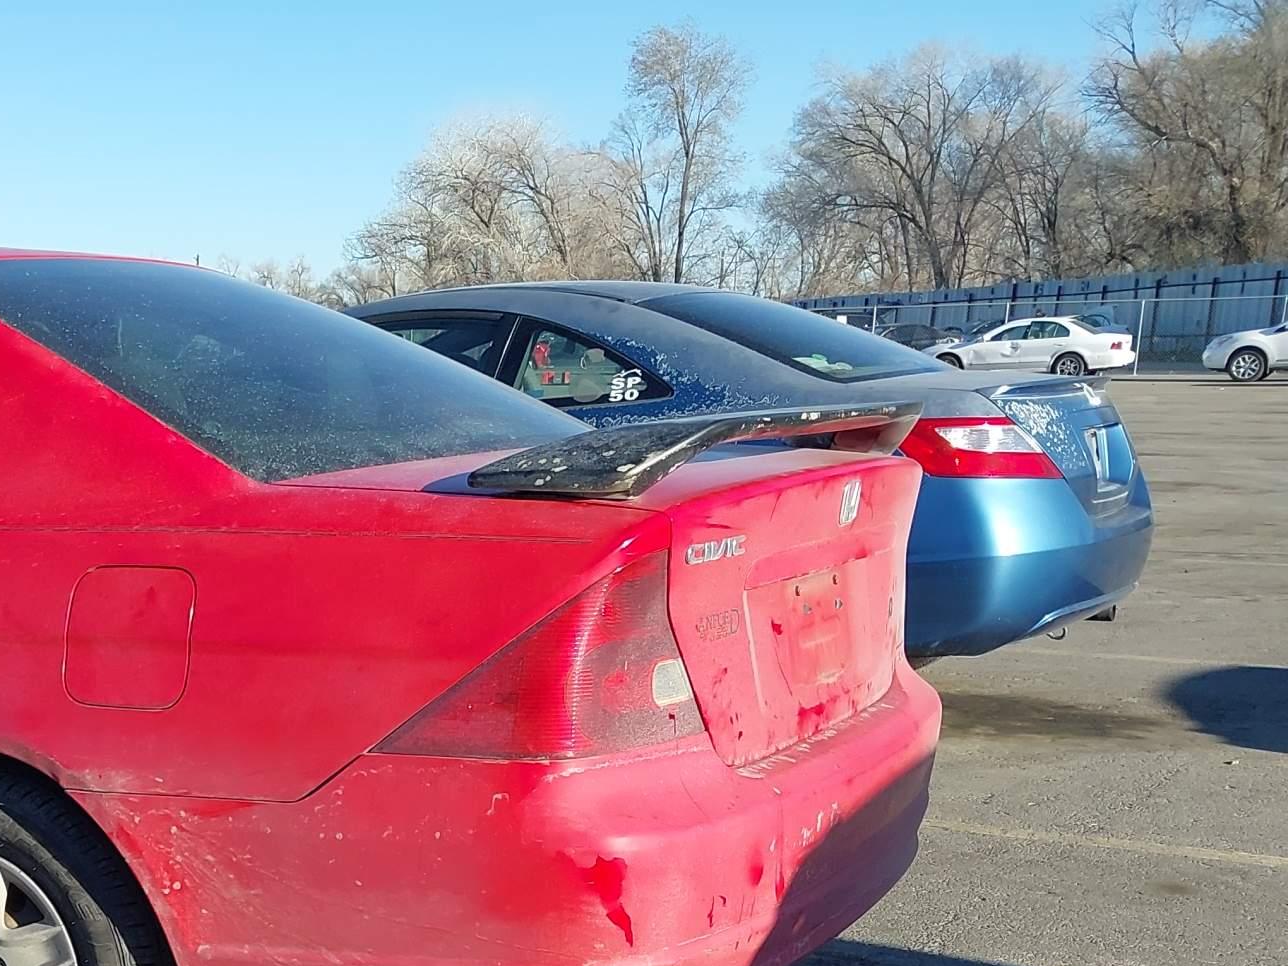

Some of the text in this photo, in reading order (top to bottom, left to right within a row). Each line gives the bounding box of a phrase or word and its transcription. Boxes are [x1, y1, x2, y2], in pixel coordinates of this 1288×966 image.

[610, 376, 642, 389] SP
[608, 389, 640, 402] 50
[686, 535, 746, 565] CIVIC
